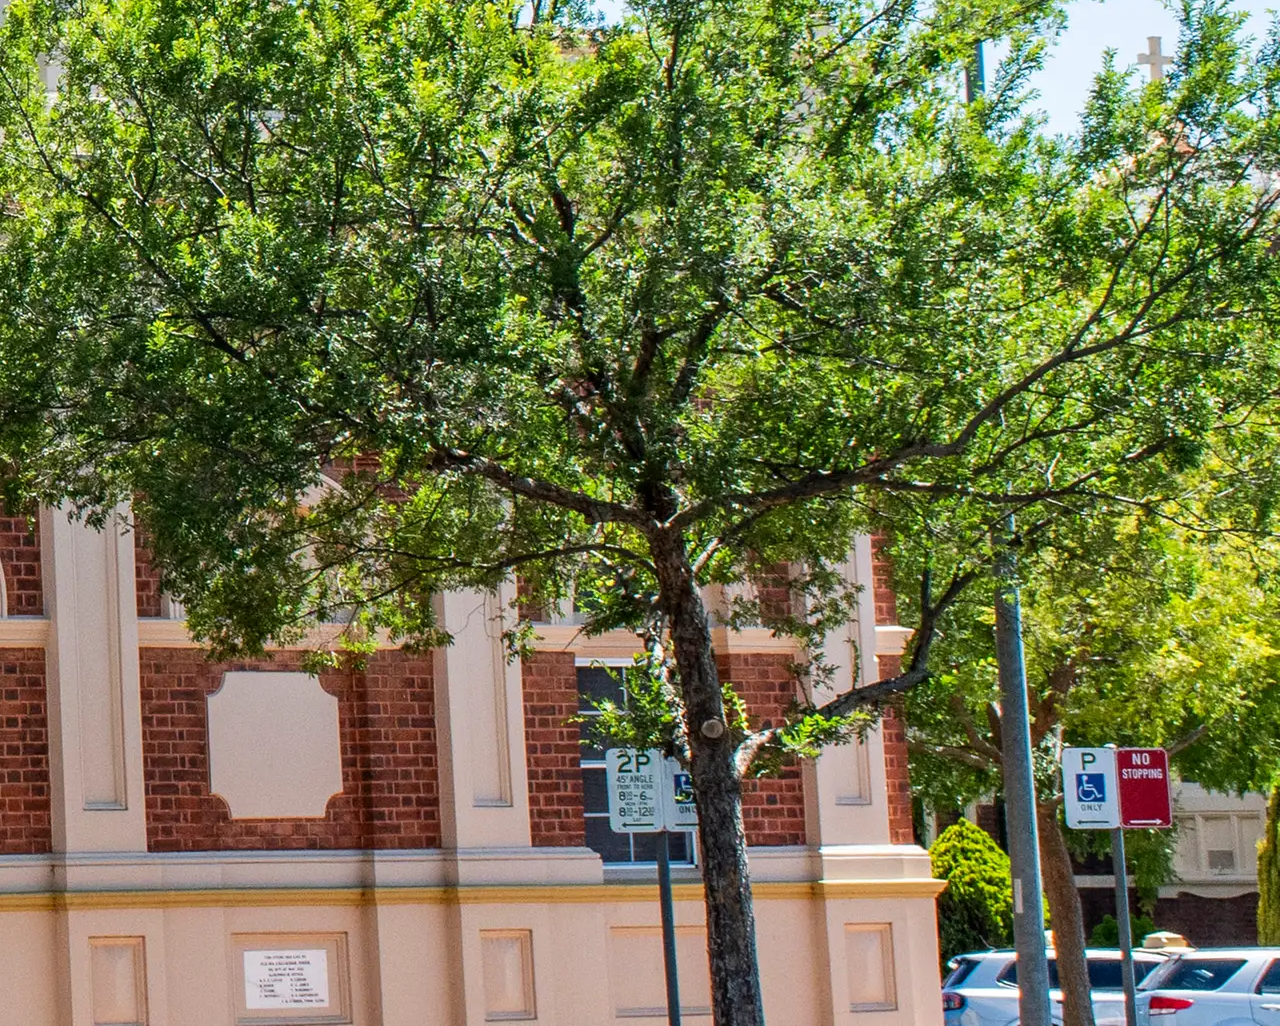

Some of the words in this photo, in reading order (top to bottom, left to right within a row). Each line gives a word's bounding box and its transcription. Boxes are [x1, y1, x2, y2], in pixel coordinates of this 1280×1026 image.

[616, 754, 650, 773] 2P
[1080, 752, 1096, 771] P
[1131, 753, 1151, 765] NO
[630, 774, 654, 783] ANGLE
[1122, 768, 1163, 779] STOPPING
